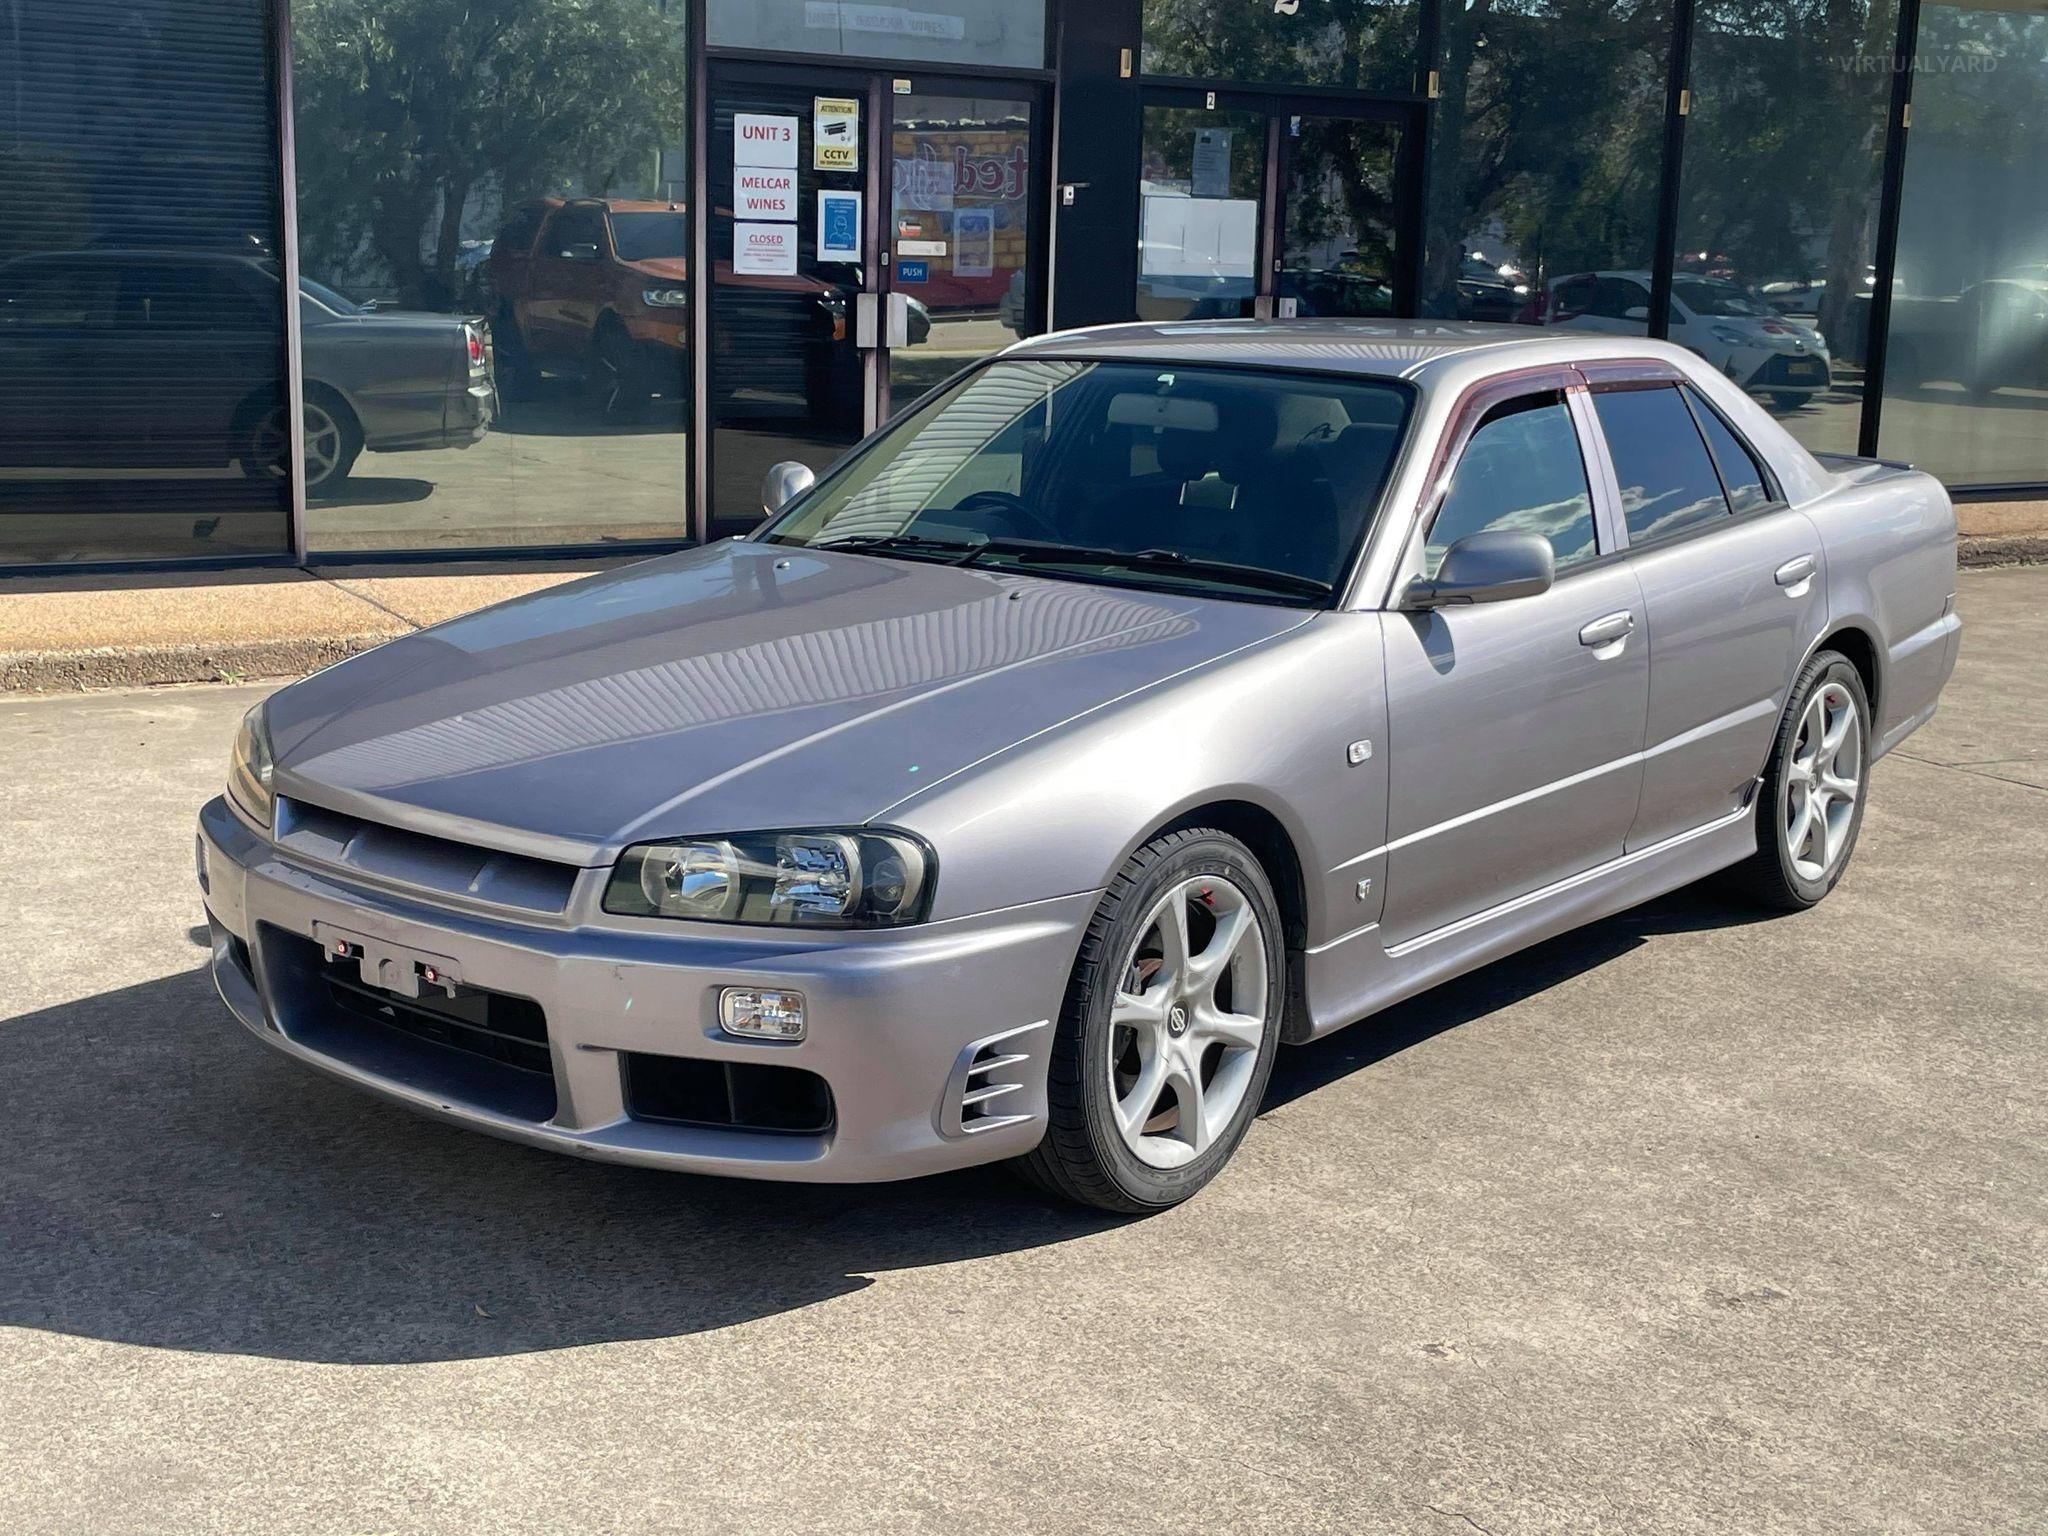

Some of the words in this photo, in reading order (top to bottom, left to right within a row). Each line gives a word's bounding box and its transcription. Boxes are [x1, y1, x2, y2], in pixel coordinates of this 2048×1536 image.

[1208, 95, 1214, 106] 2
[820, 104, 853, 115] ATTENTION
[742, 125, 779, 141] UNIT
[781, 127, 791, 142] 3
[823, 149, 849, 161] CCTV
[741, 176, 791, 190] MELCAR
[746, 198, 786, 211] WINES
[749, 233, 784, 245] CLOSED
[902, 266, 923, 277] PUSH
